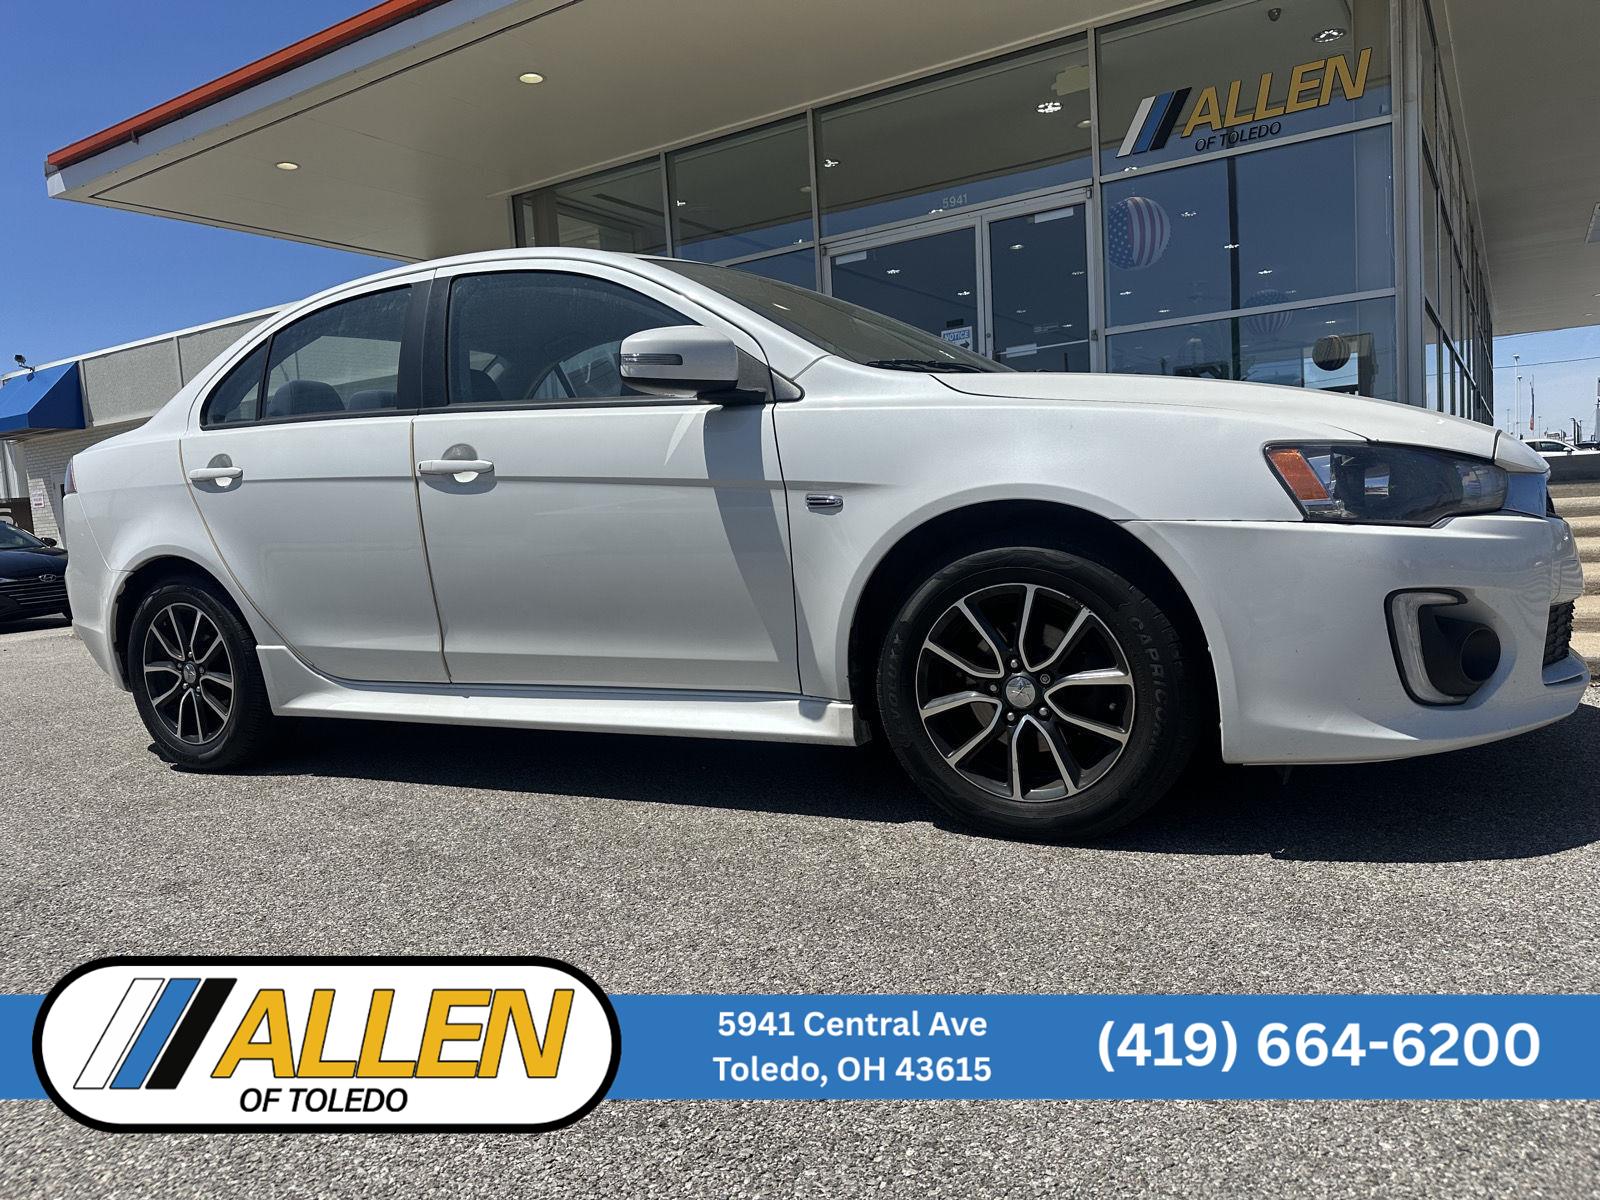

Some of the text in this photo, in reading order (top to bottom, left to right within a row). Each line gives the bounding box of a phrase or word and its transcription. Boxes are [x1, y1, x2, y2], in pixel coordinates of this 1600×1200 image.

[1180, 47, 1372, 138] ALLEN
[1195, 121, 1282, 152] OF TOLEDO
[943, 192, 968, 209] 5941
[943, 330, 970, 342] NOTICE
